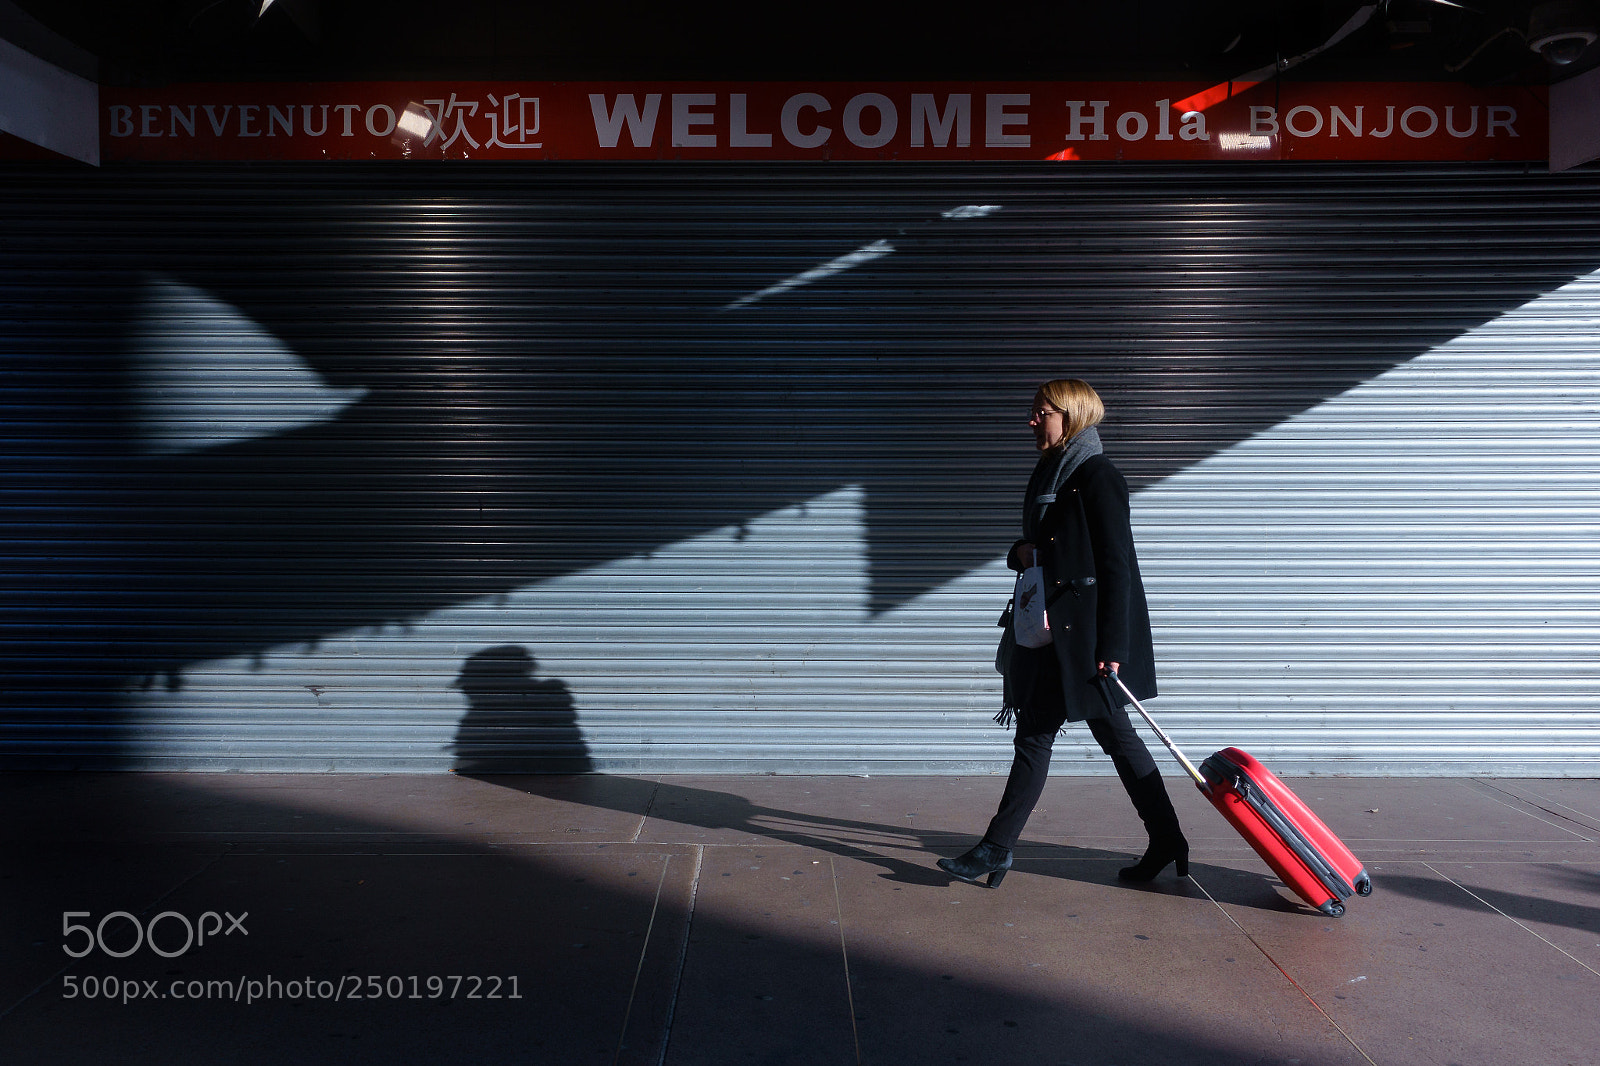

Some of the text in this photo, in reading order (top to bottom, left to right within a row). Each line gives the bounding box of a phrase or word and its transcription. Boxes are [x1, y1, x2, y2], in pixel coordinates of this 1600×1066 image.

[108, 104, 397, 138] BENVENUTO
[422, 93, 543, 151] 欢迎
[588, 93, 1033, 148] WELCOME
[1065, 100, 1208, 141] Hola
[1249, 105, 1520, 138] BONJOUR
